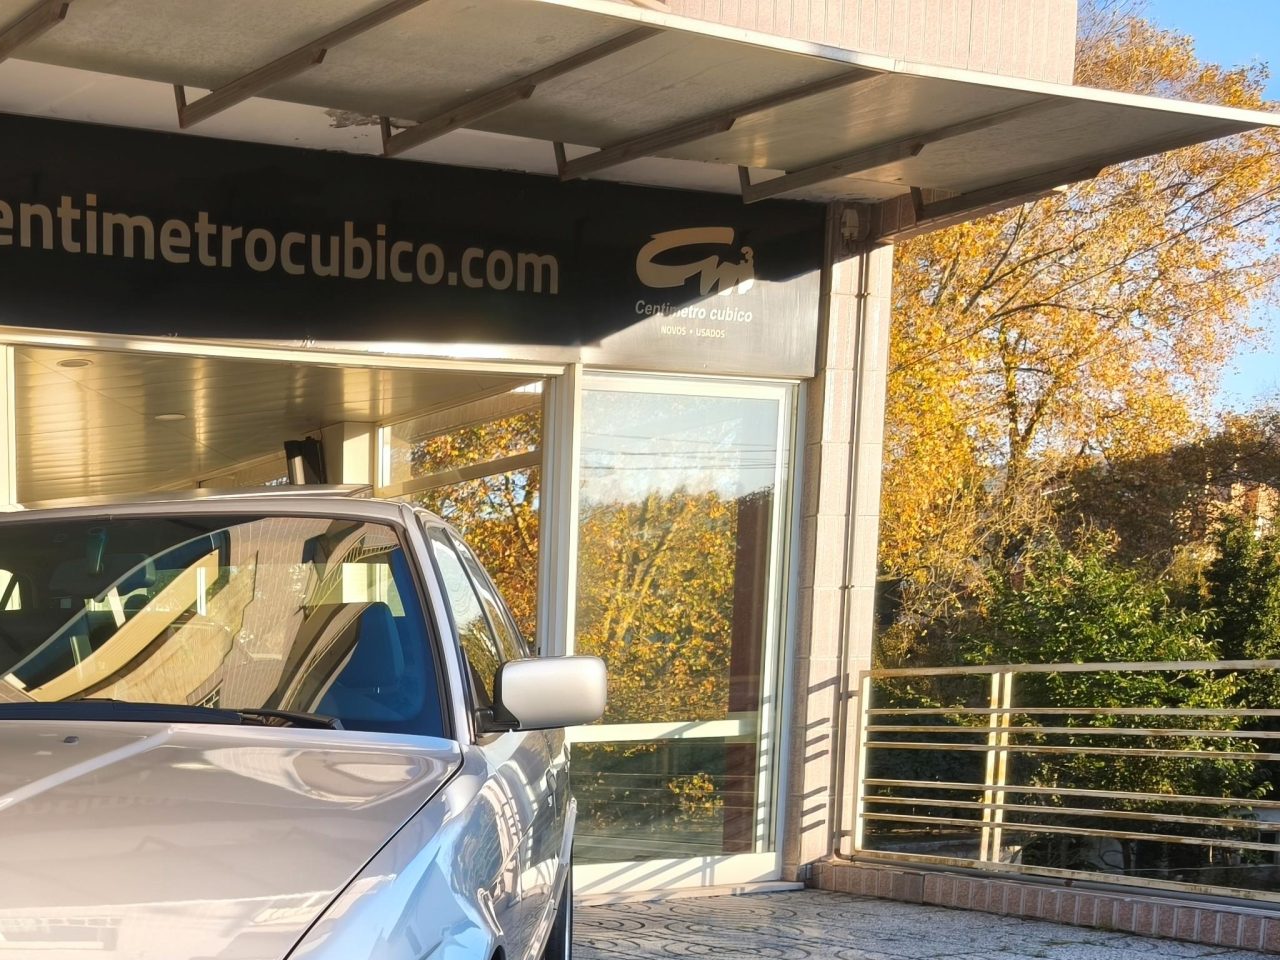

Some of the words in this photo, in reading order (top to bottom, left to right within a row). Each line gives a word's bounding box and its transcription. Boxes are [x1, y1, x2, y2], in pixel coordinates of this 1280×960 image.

[708, 306, 754, 323] cubico
[660, 324, 687, 336] NOVOS
[695, 326, 726, 339] USADOS
